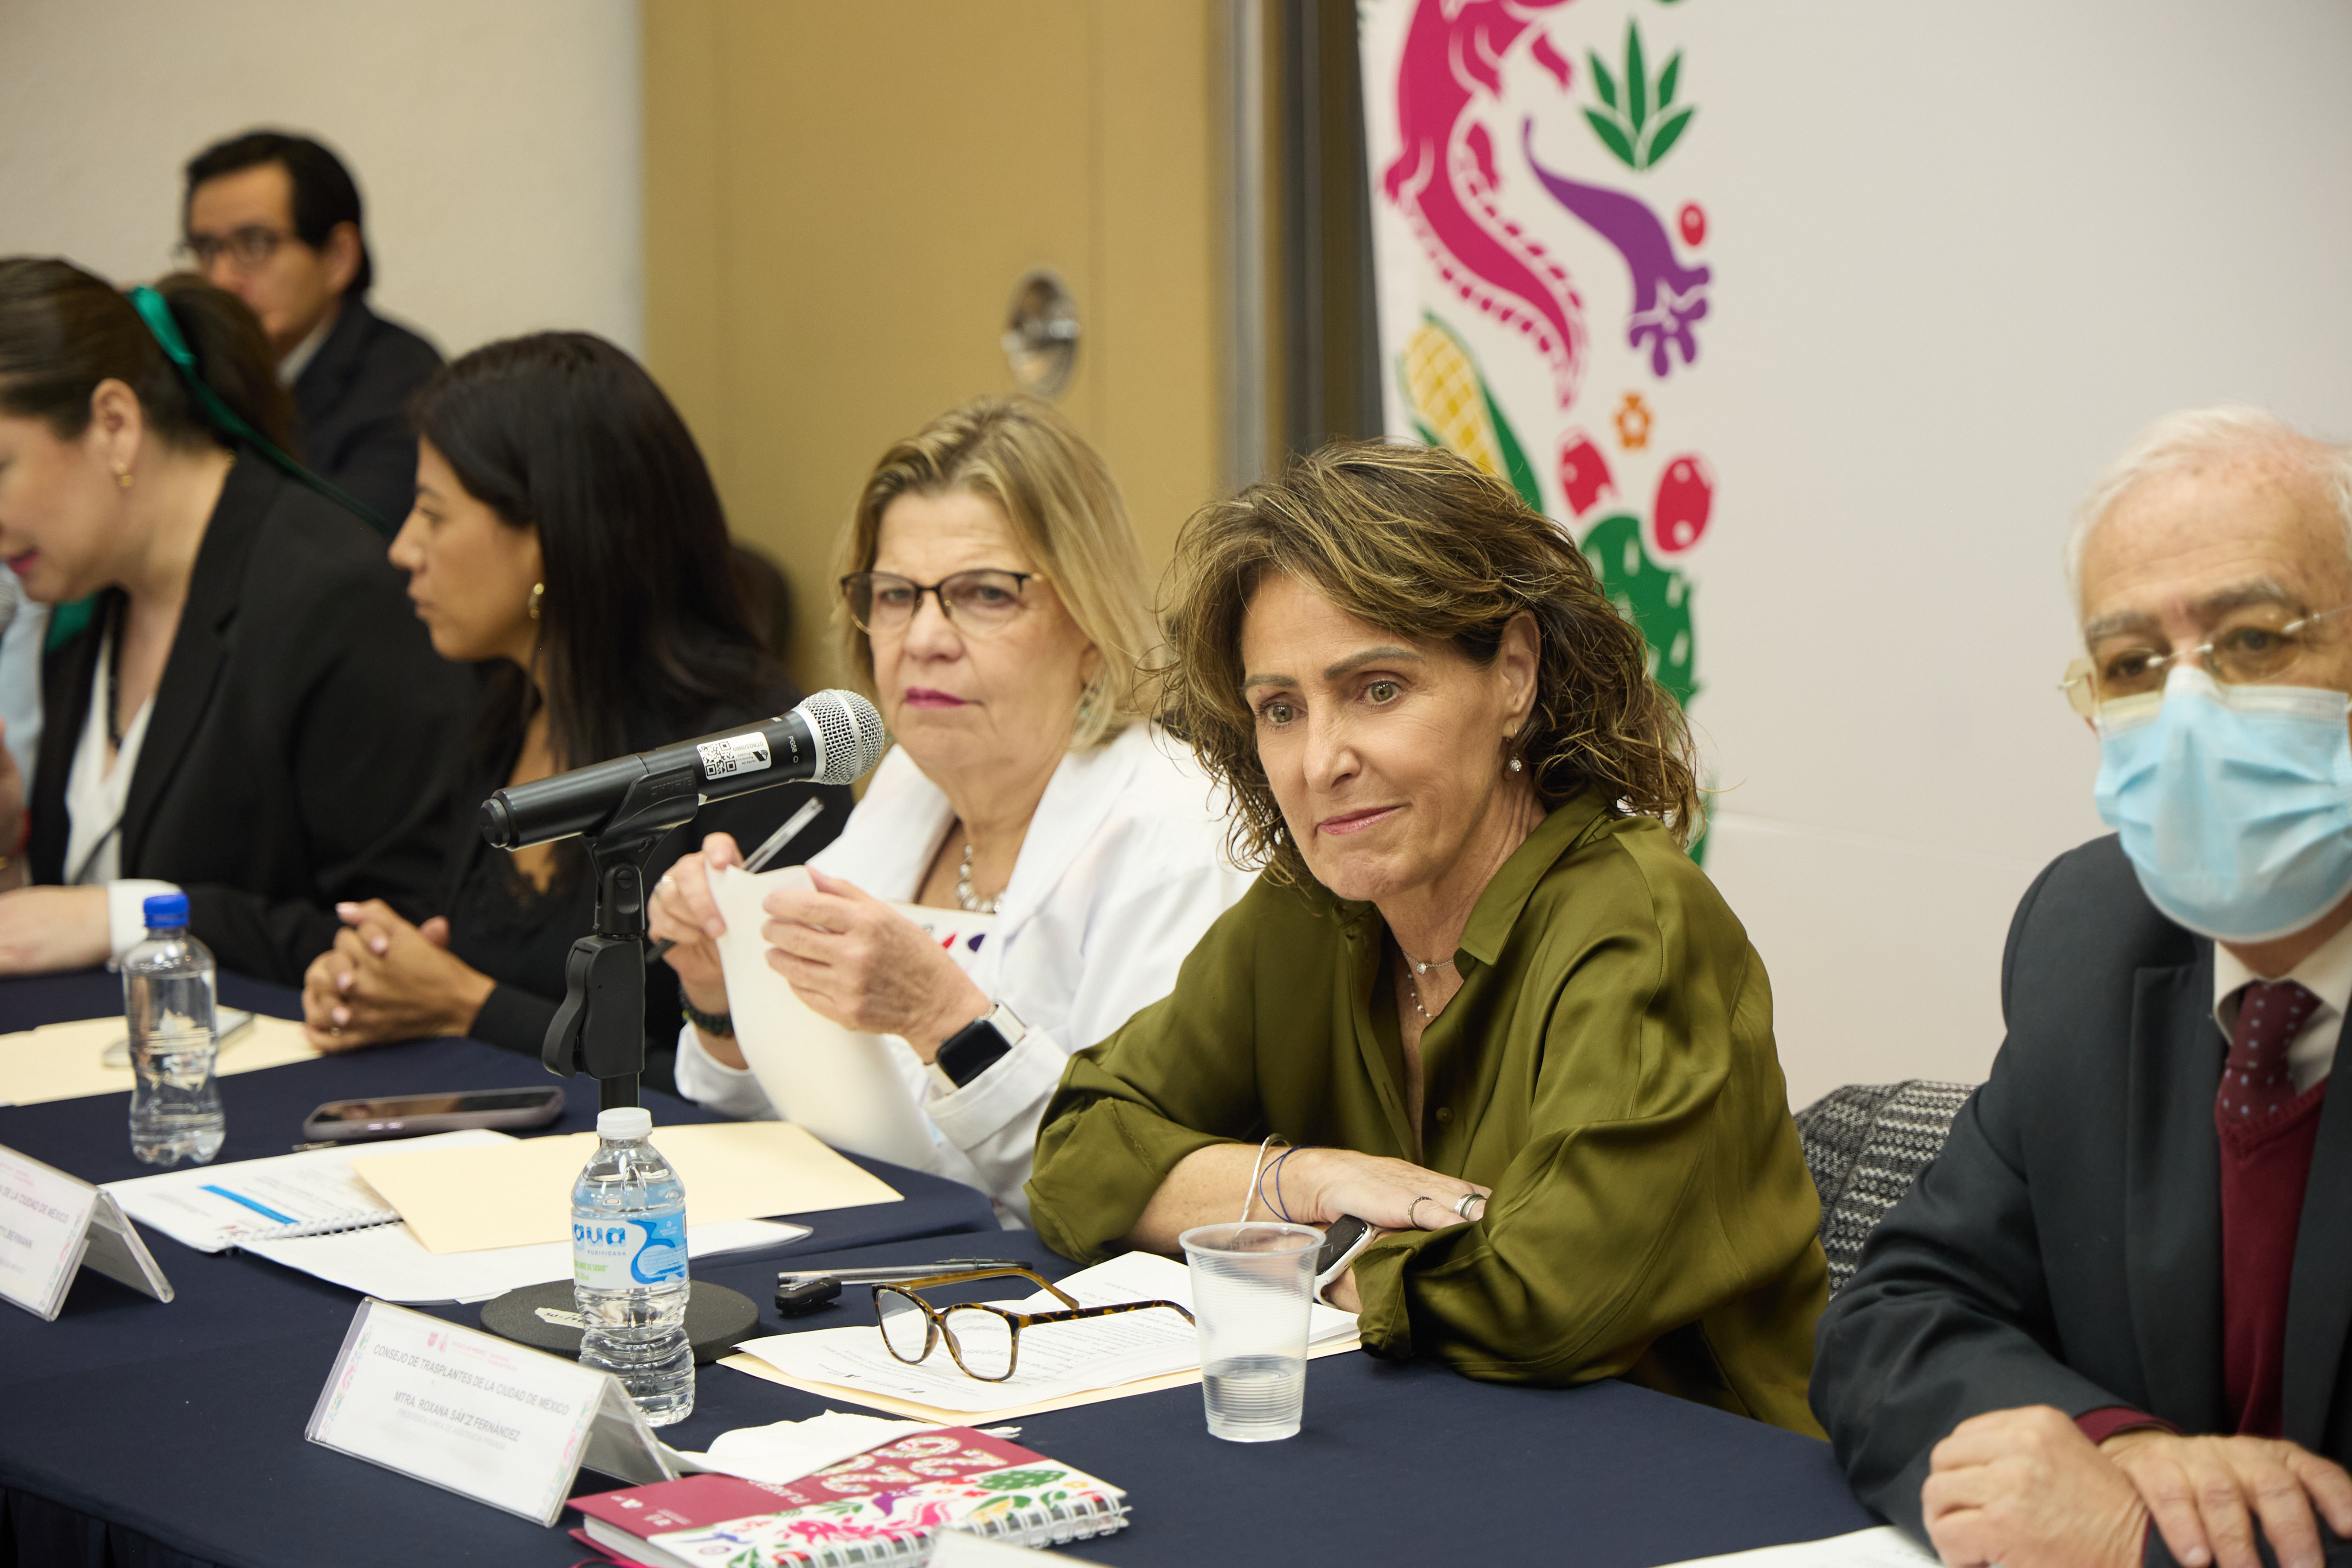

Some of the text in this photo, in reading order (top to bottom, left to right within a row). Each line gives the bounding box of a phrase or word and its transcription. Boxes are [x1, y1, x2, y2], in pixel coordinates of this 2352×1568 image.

[788, 736, 798, 753] PG58
[373, 1344, 570, 1415] CONSEJO DE TRASPLANTES DE LA CIUDAD DE MÉXICO
[394, 1390, 415, 1407] MTRA.
[417, 1399, 449, 1418] ROXANA
[473, 1418, 521, 1441] FERNÁNDEZ
